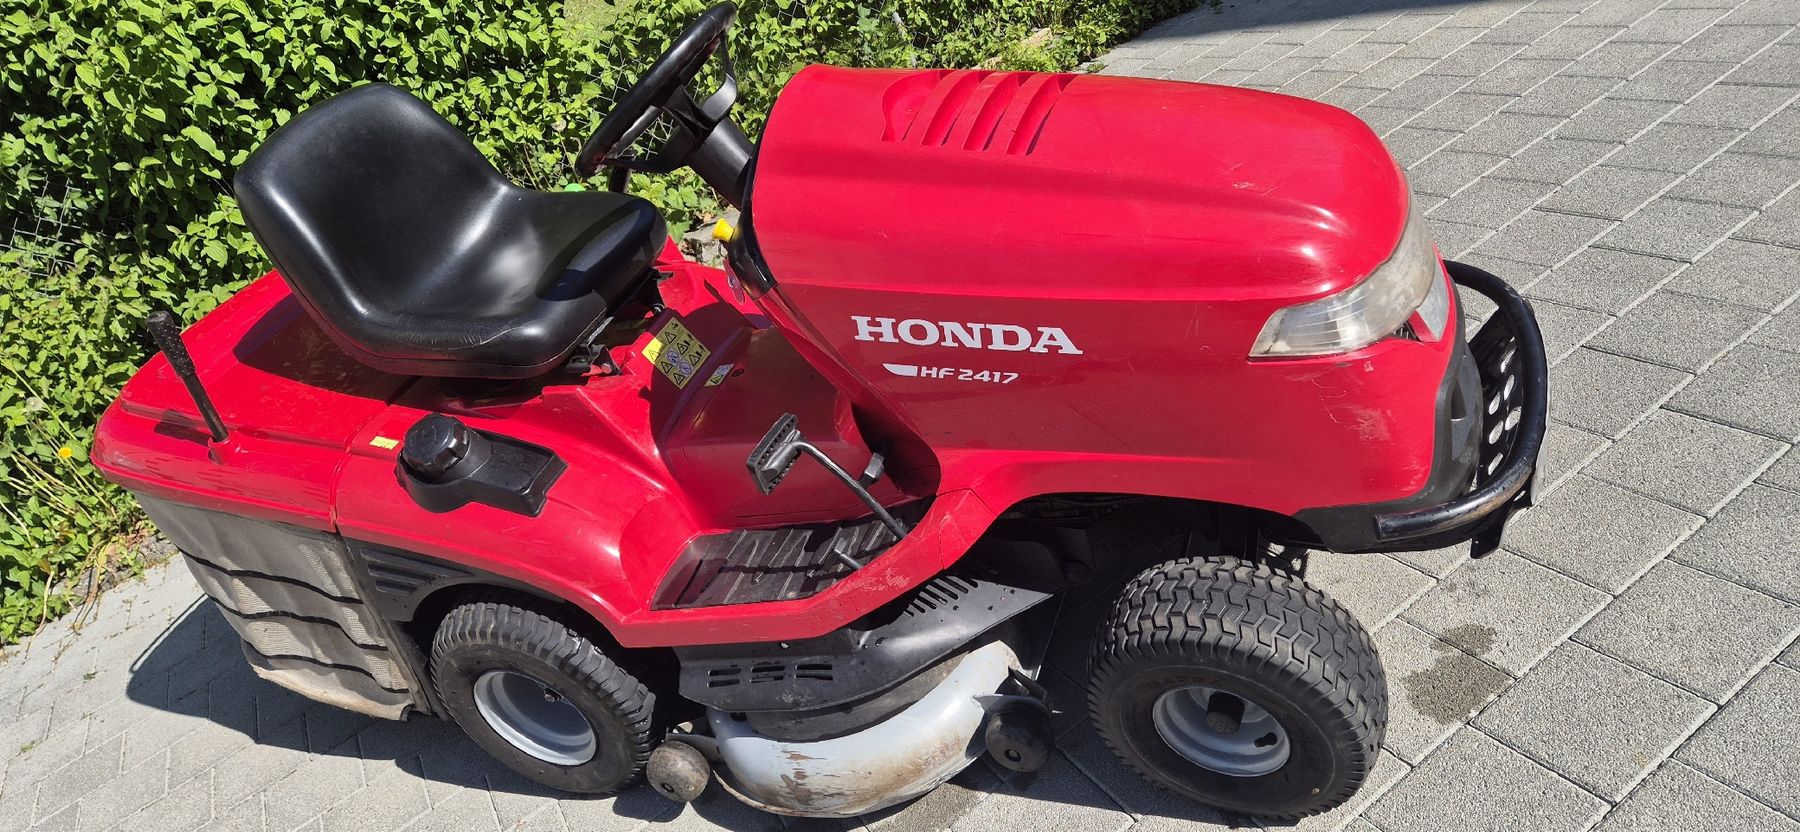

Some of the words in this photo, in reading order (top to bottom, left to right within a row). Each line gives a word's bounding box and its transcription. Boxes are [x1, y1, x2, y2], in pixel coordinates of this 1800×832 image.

[851, 315, 1083, 354] HONDA
[920, 366, 955, 379] HF
[958, 368, 1018, 384] 2417
